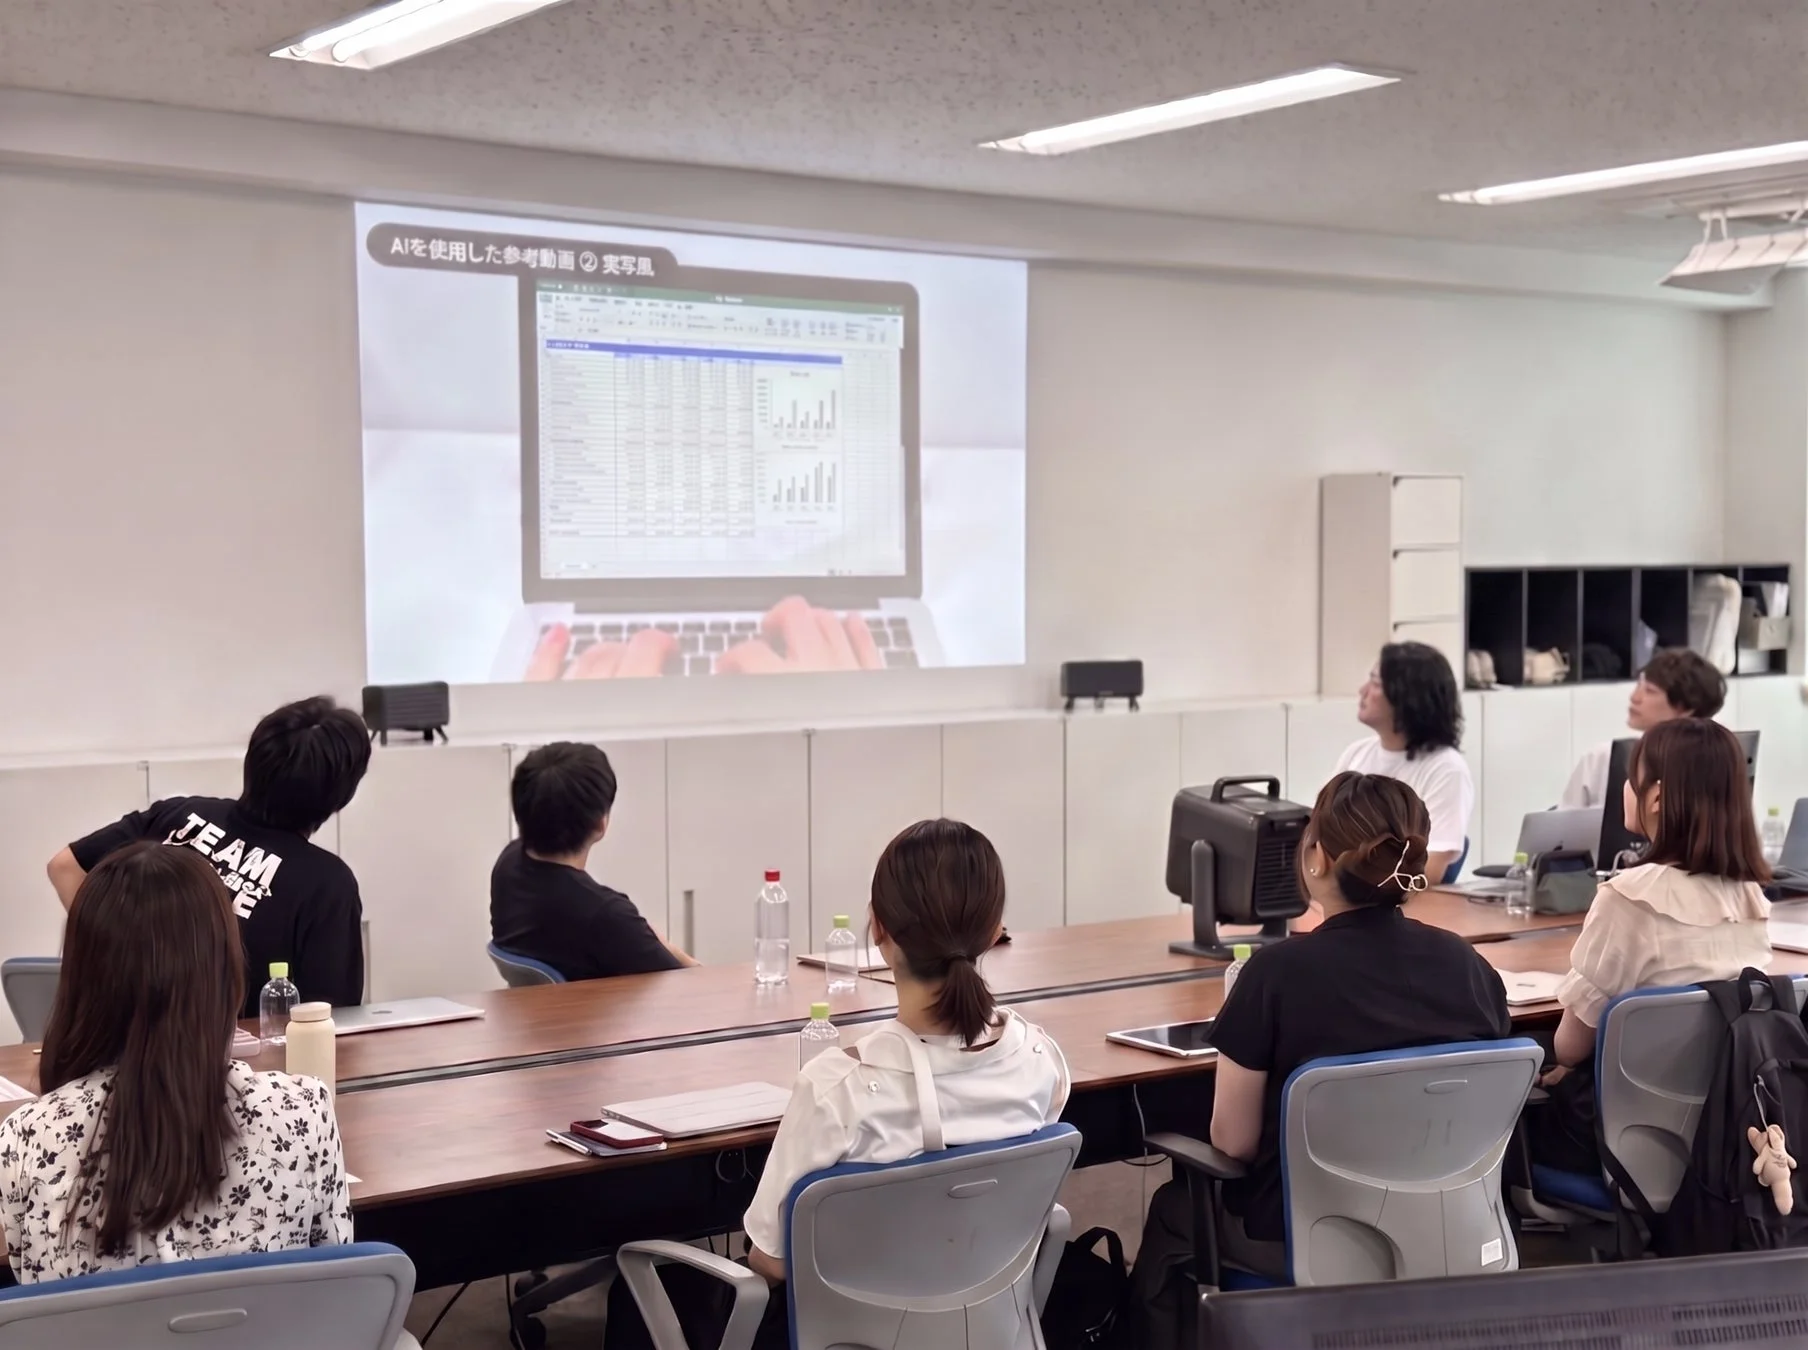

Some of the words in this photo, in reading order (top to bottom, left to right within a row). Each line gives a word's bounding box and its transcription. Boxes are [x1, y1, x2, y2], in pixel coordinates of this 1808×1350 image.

[390, 237, 575, 271] AIを使用した参考動画
[602, 254, 654, 277] 実写風
[175, 812, 283, 887] TEAM
